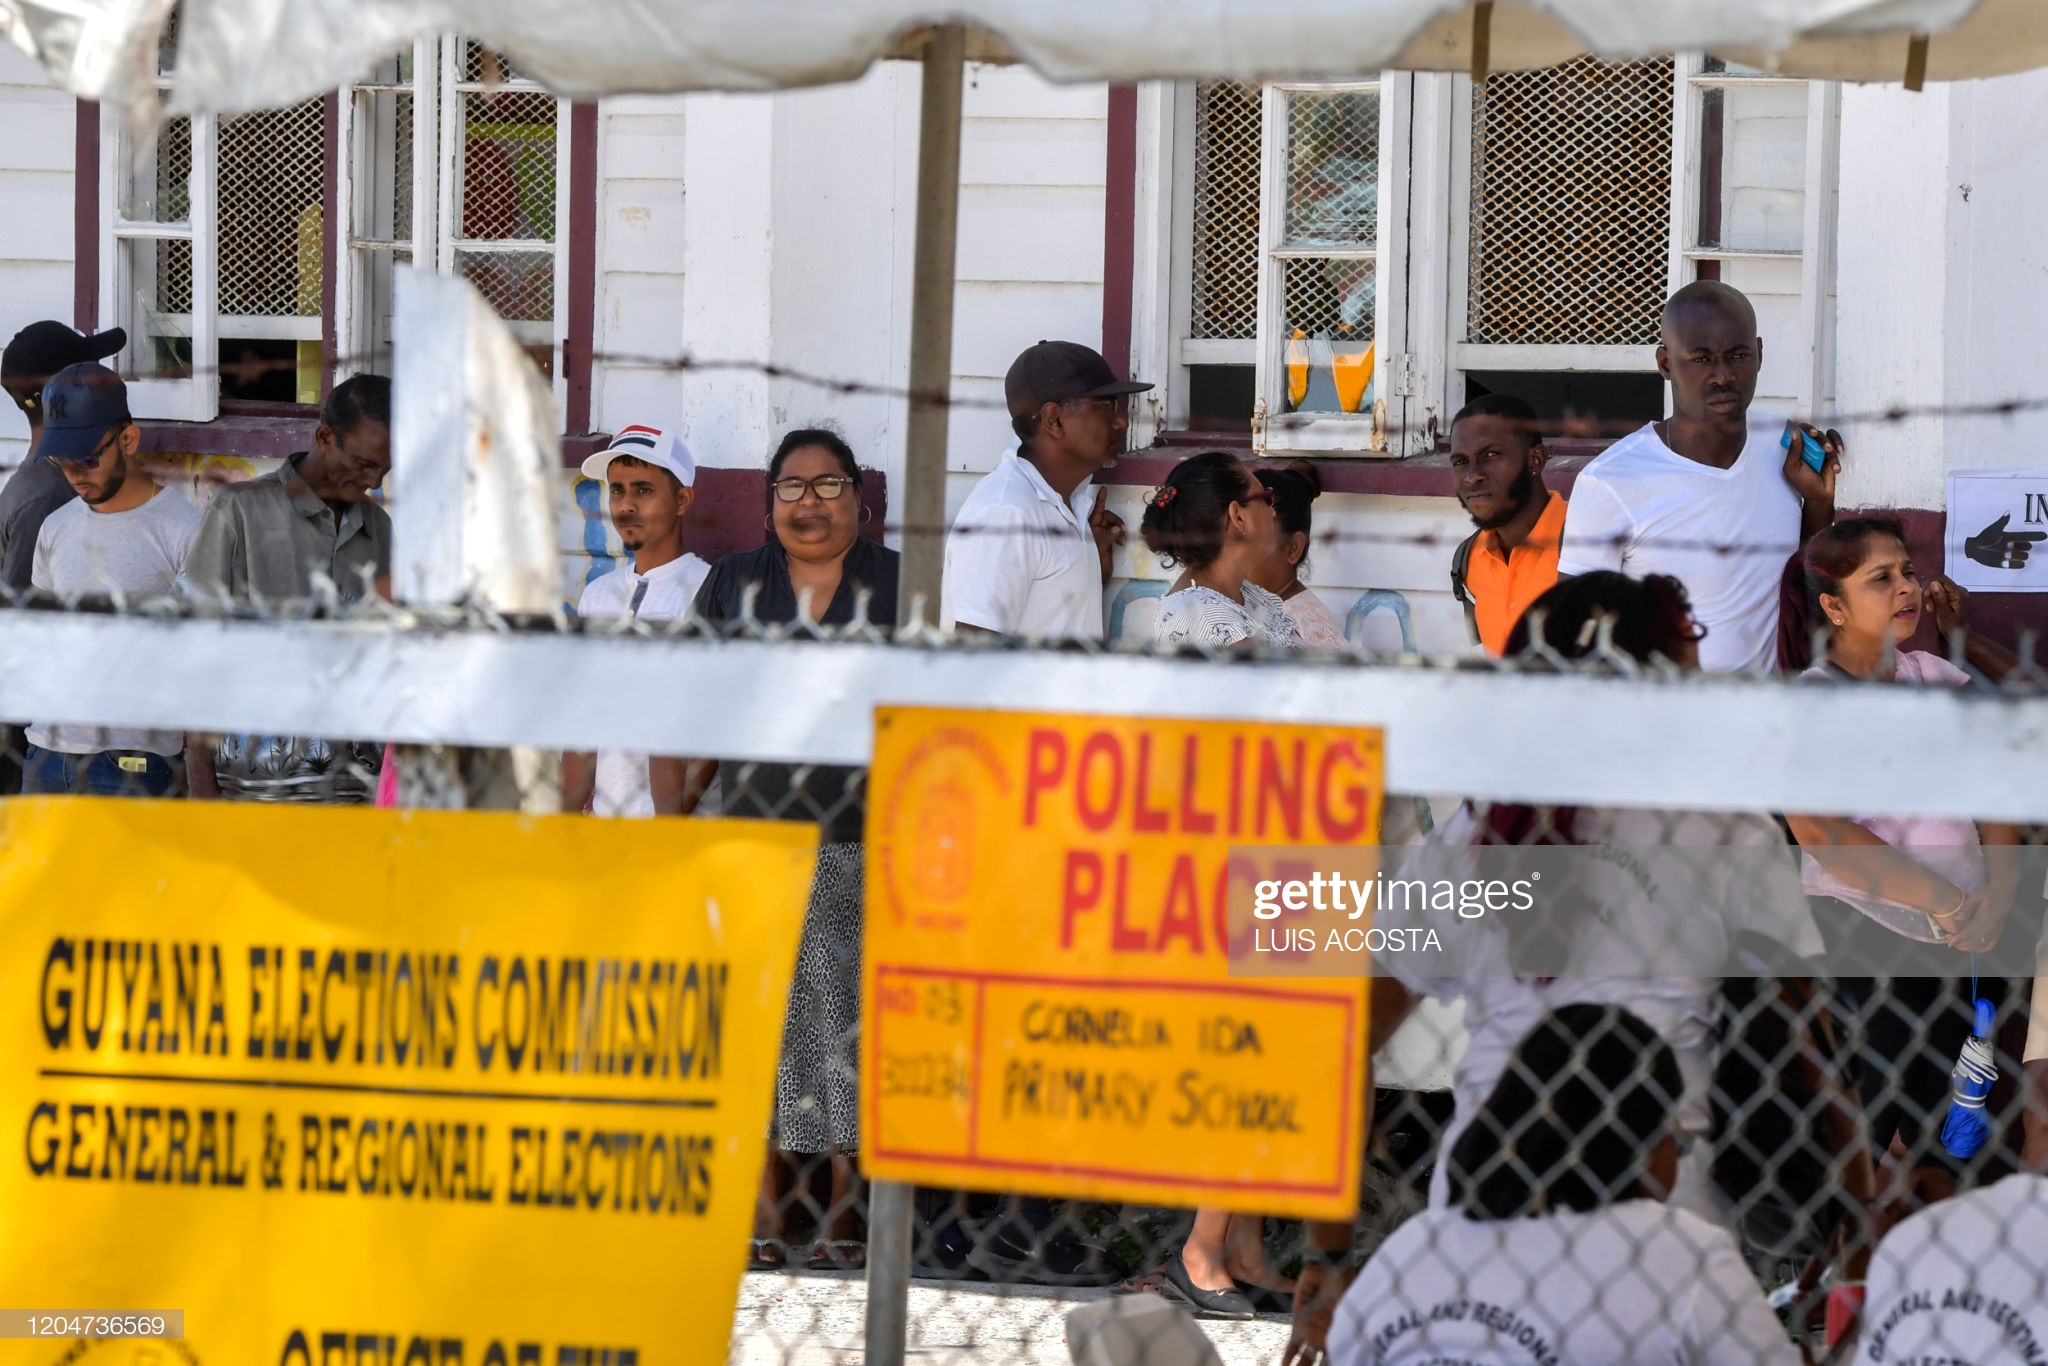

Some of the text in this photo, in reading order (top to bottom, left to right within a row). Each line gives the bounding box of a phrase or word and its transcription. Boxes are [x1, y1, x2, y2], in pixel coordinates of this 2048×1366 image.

[1021, 729, 1370, 844] POLLING
[1057, 850, 1317, 965] PLACE
[40, 937, 729, 1080] GUYANA ELECTIONS COMMISSION
[1019, 999, 1264, 1057] CORNELIA IDA
[1001, 1057, 1159, 1129] PRIMARY
[26, 1101, 715, 1218] GENERAL & REGIONAL ELECTIONS
[1431, 1299, 1469, 1321] AND
[1941, 1287, 1984, 1315] AND
